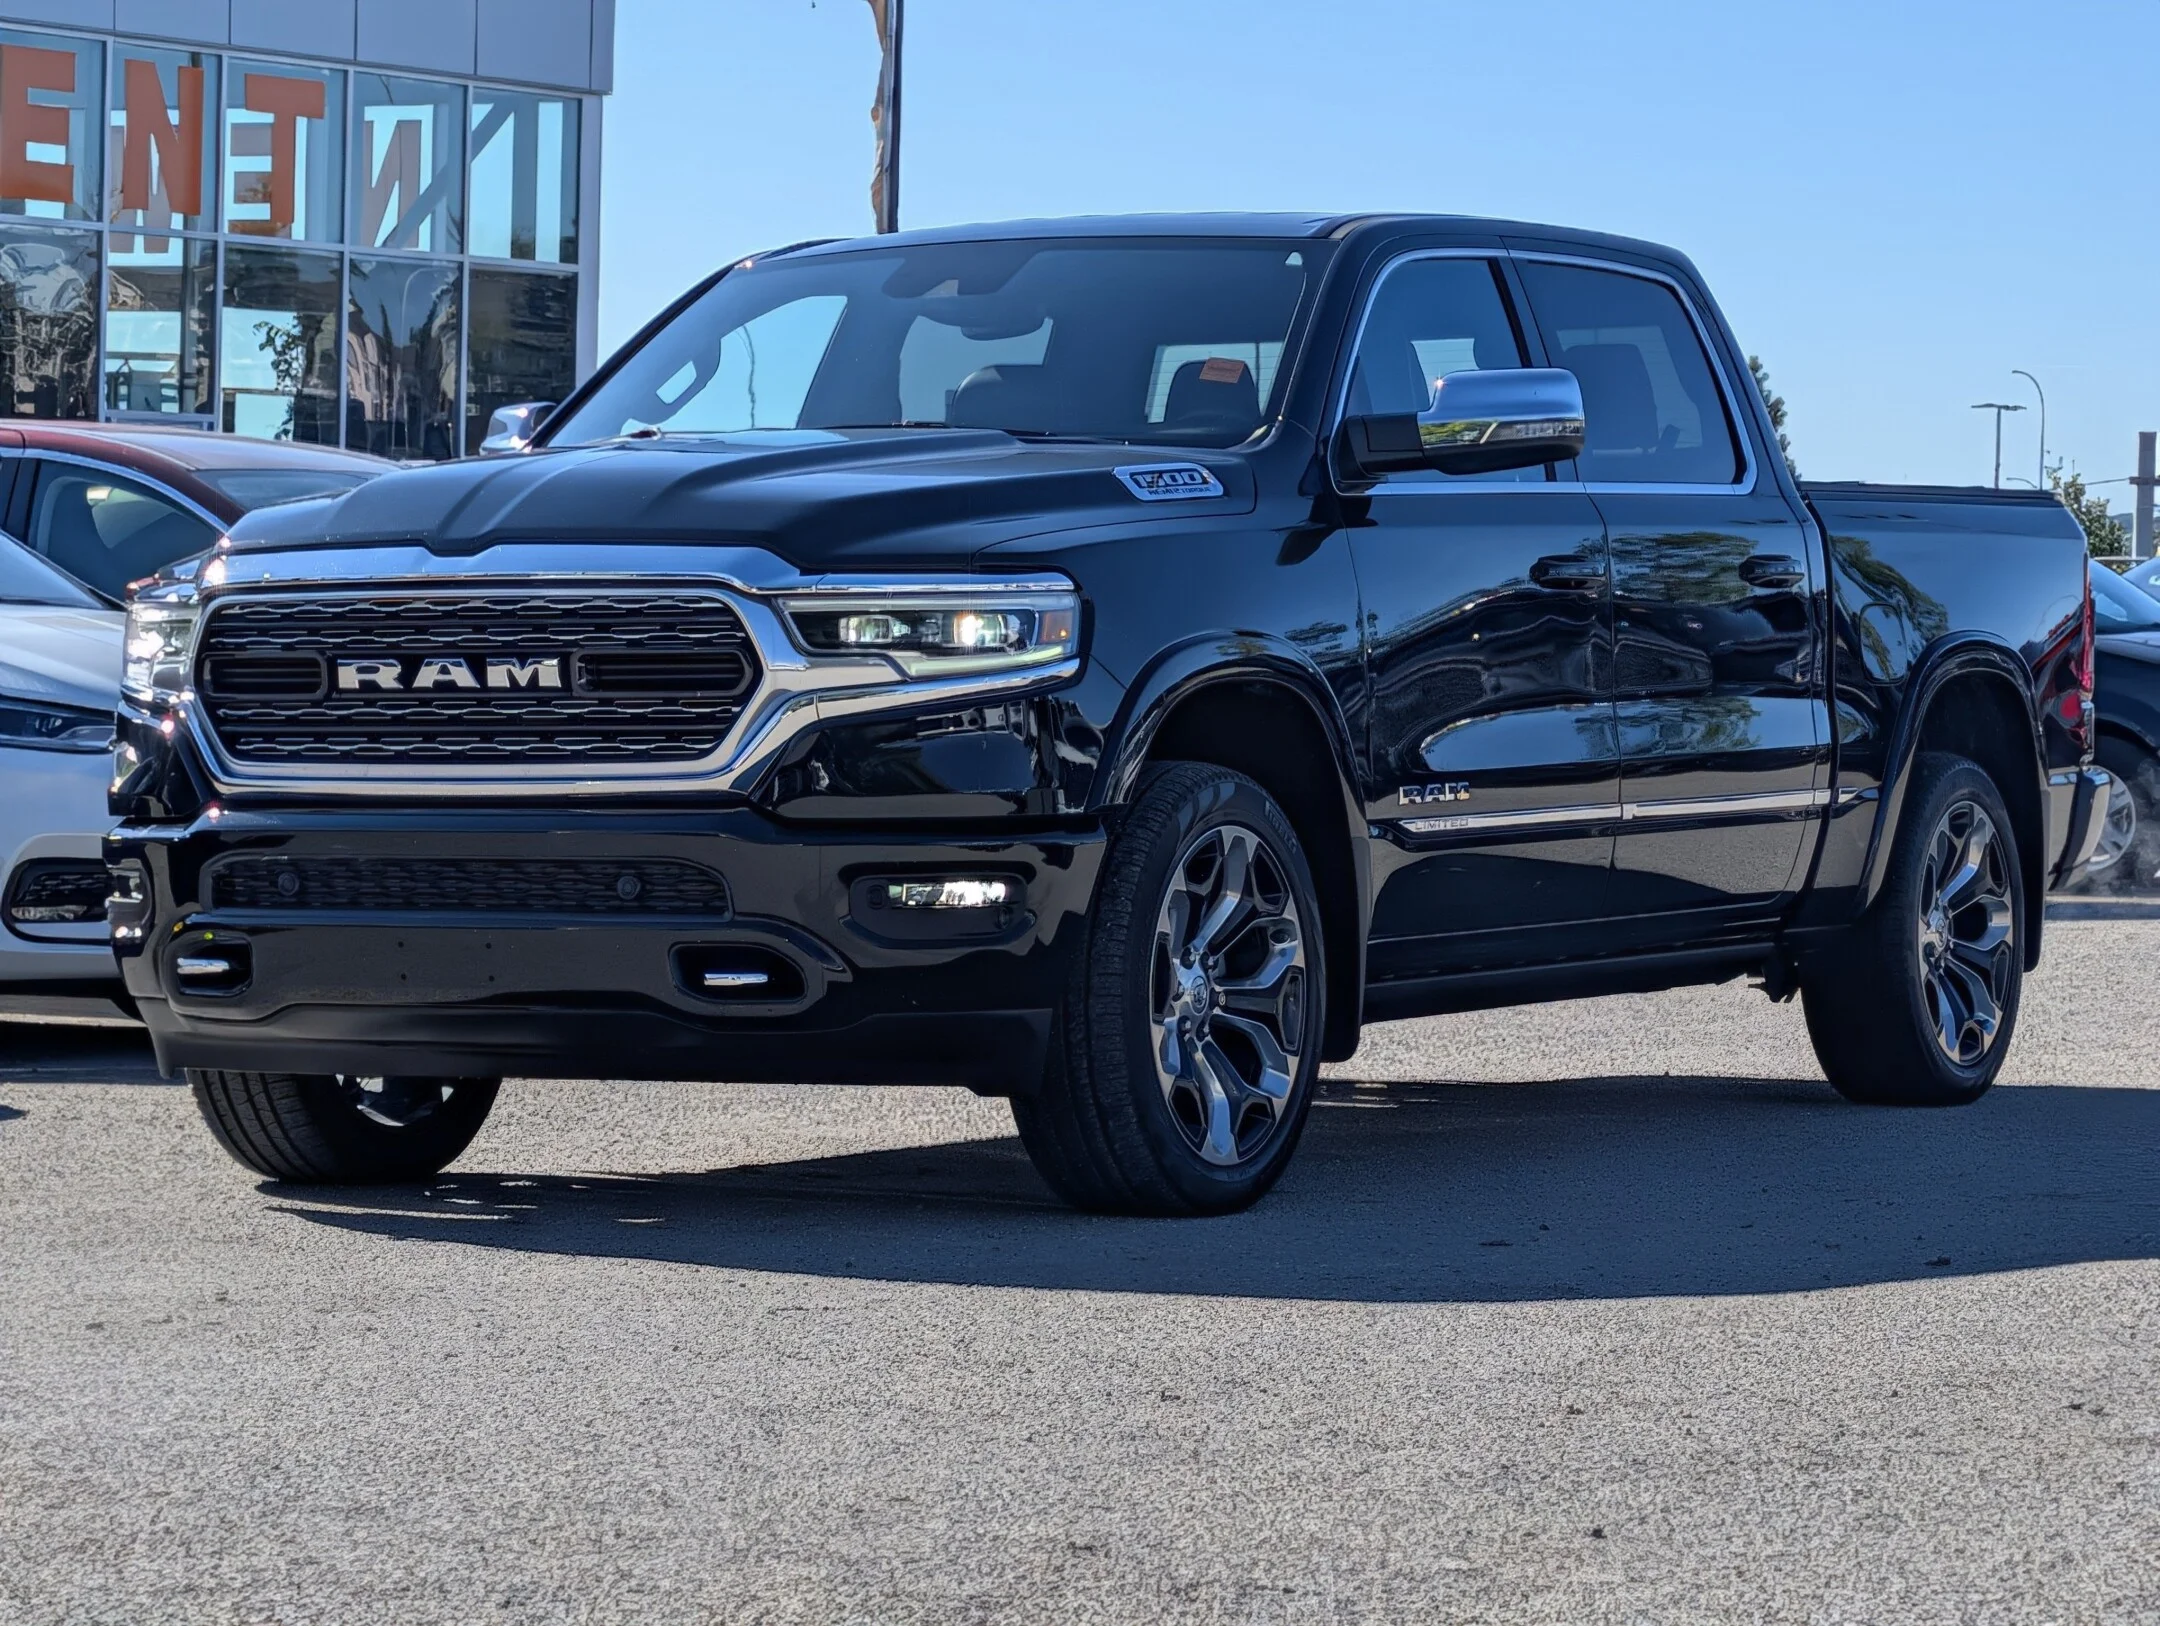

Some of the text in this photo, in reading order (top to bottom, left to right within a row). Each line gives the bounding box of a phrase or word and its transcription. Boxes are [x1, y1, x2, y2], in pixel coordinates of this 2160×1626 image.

[0, 44, 325, 226] ENT
[337, 657, 561, 689] RAM
[1414, 818, 1469, 830] LIMITED
